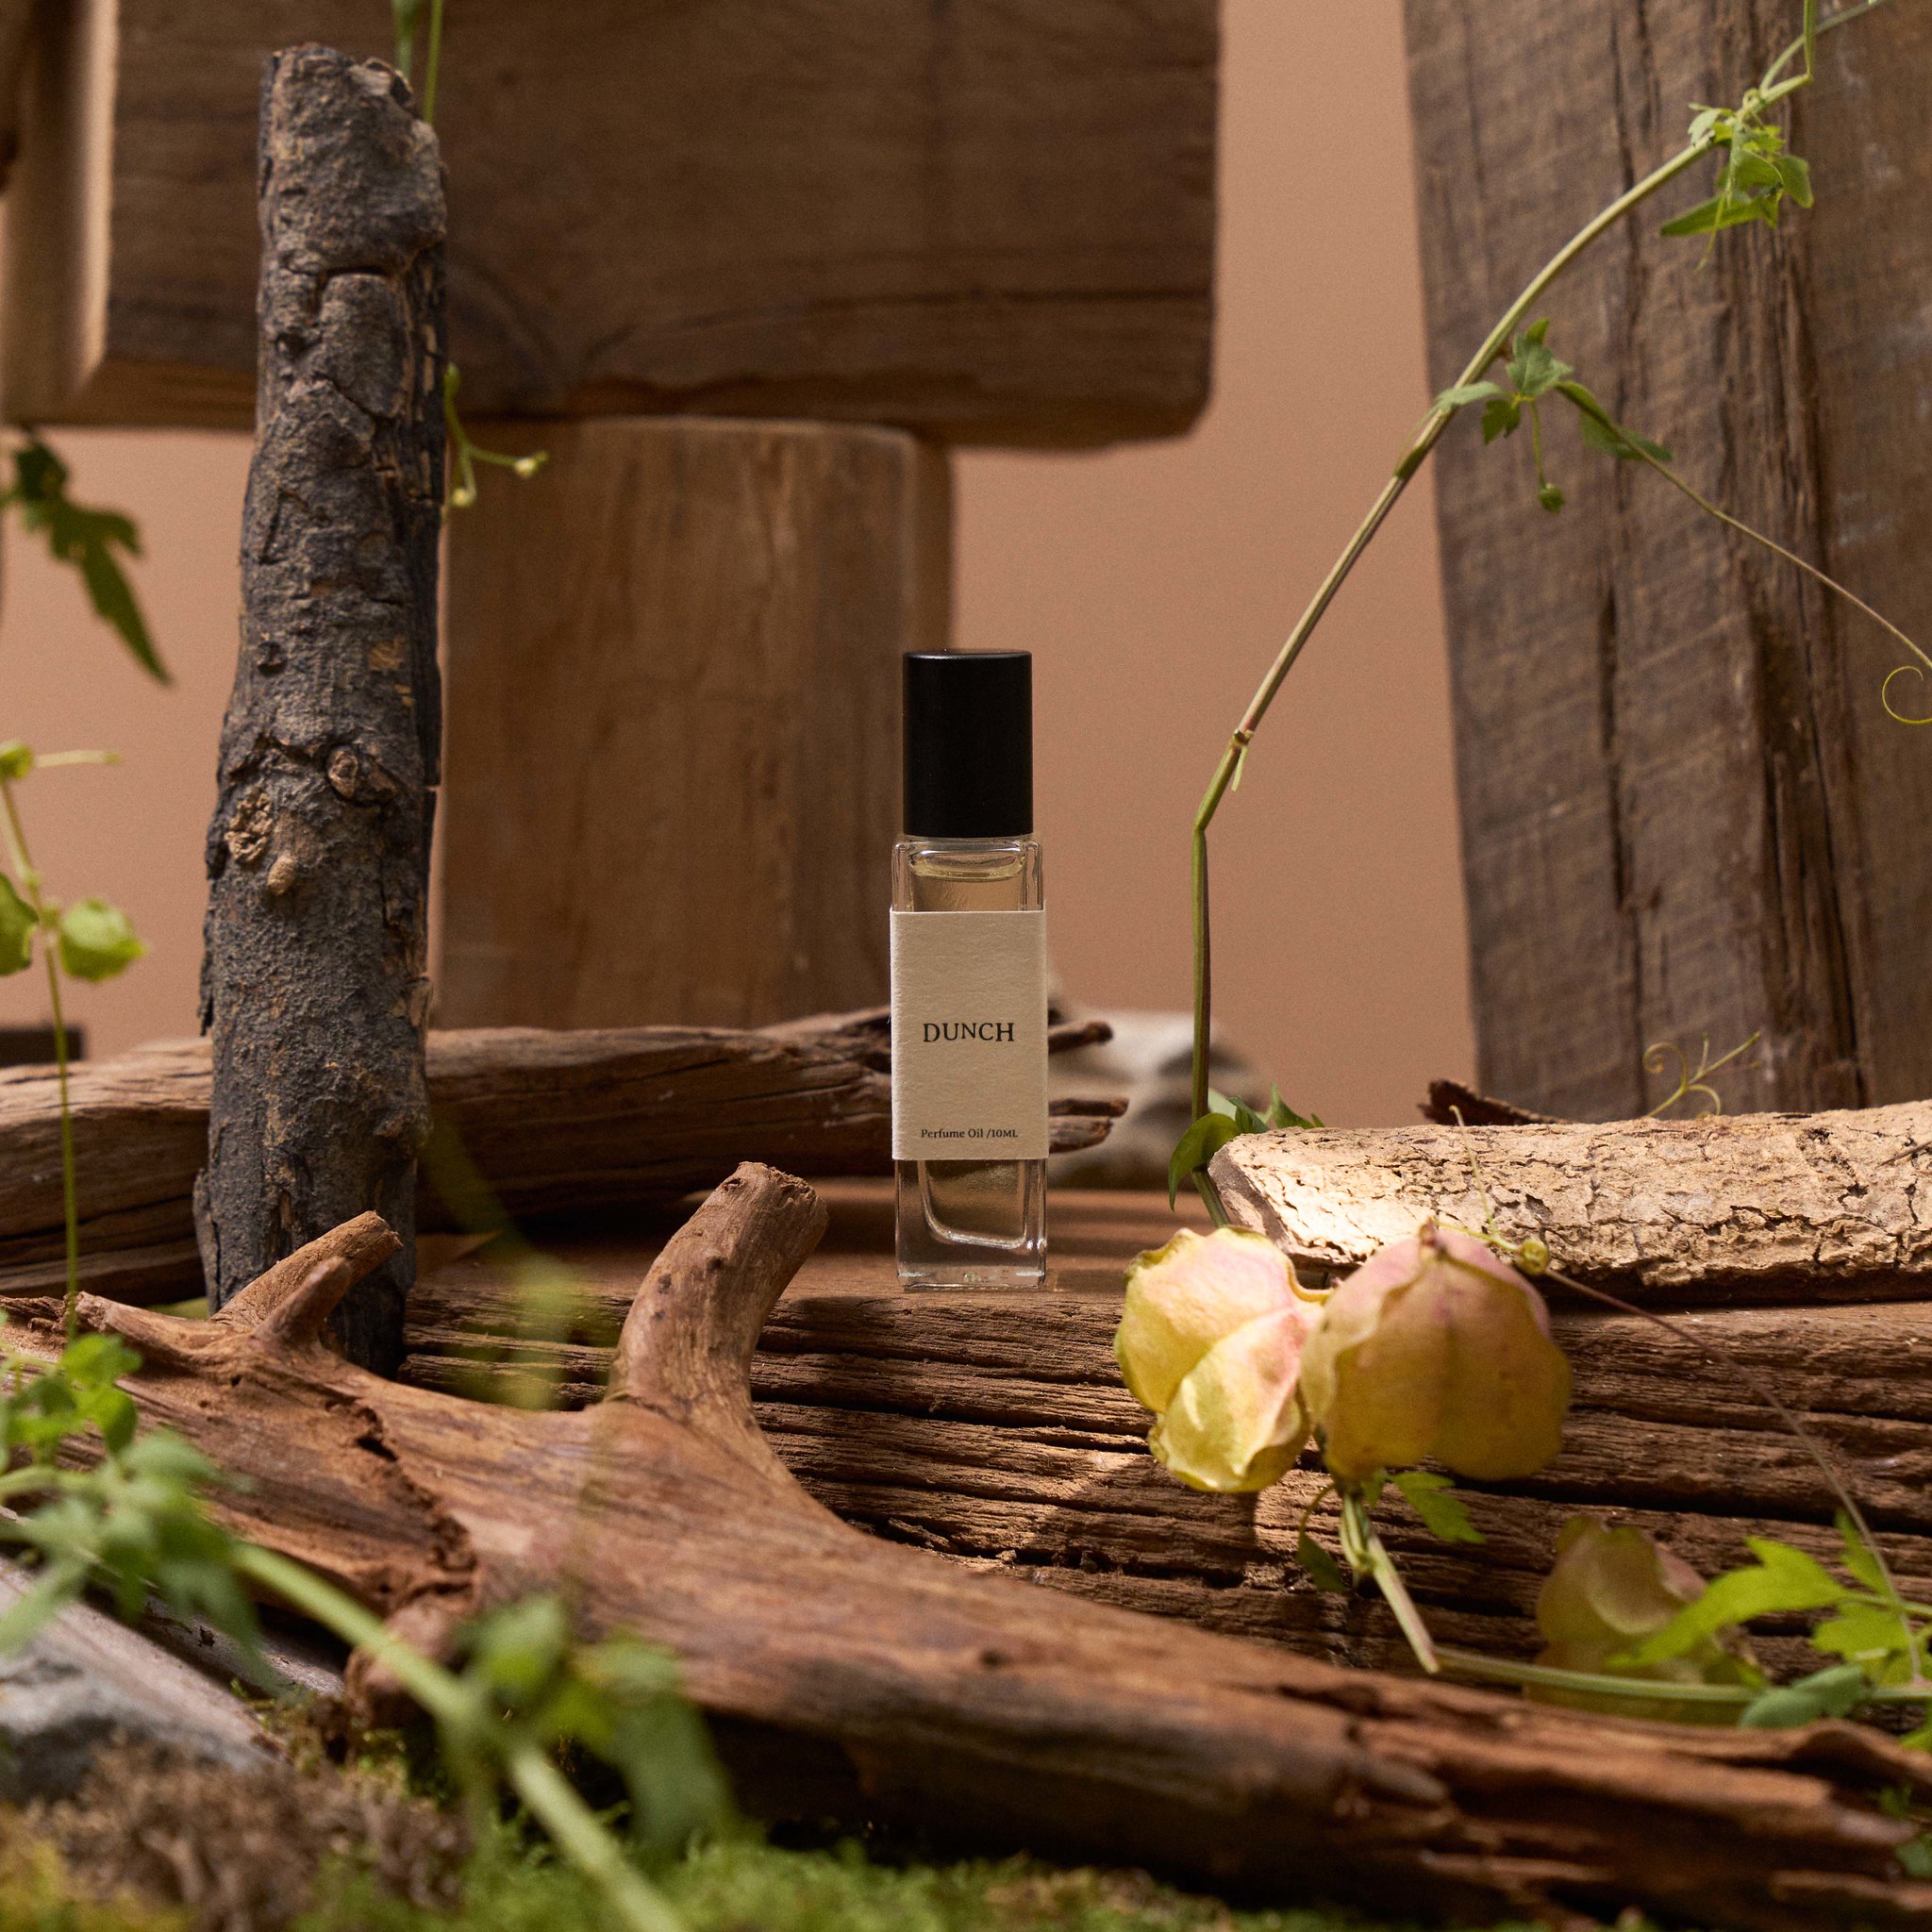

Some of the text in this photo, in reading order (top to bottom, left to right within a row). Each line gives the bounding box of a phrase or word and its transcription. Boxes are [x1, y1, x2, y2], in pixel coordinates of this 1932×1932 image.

[923, 1023, 1014, 1042] DUNCH
[921, 1128, 1019, 1139] Perfume Oil /10ML
